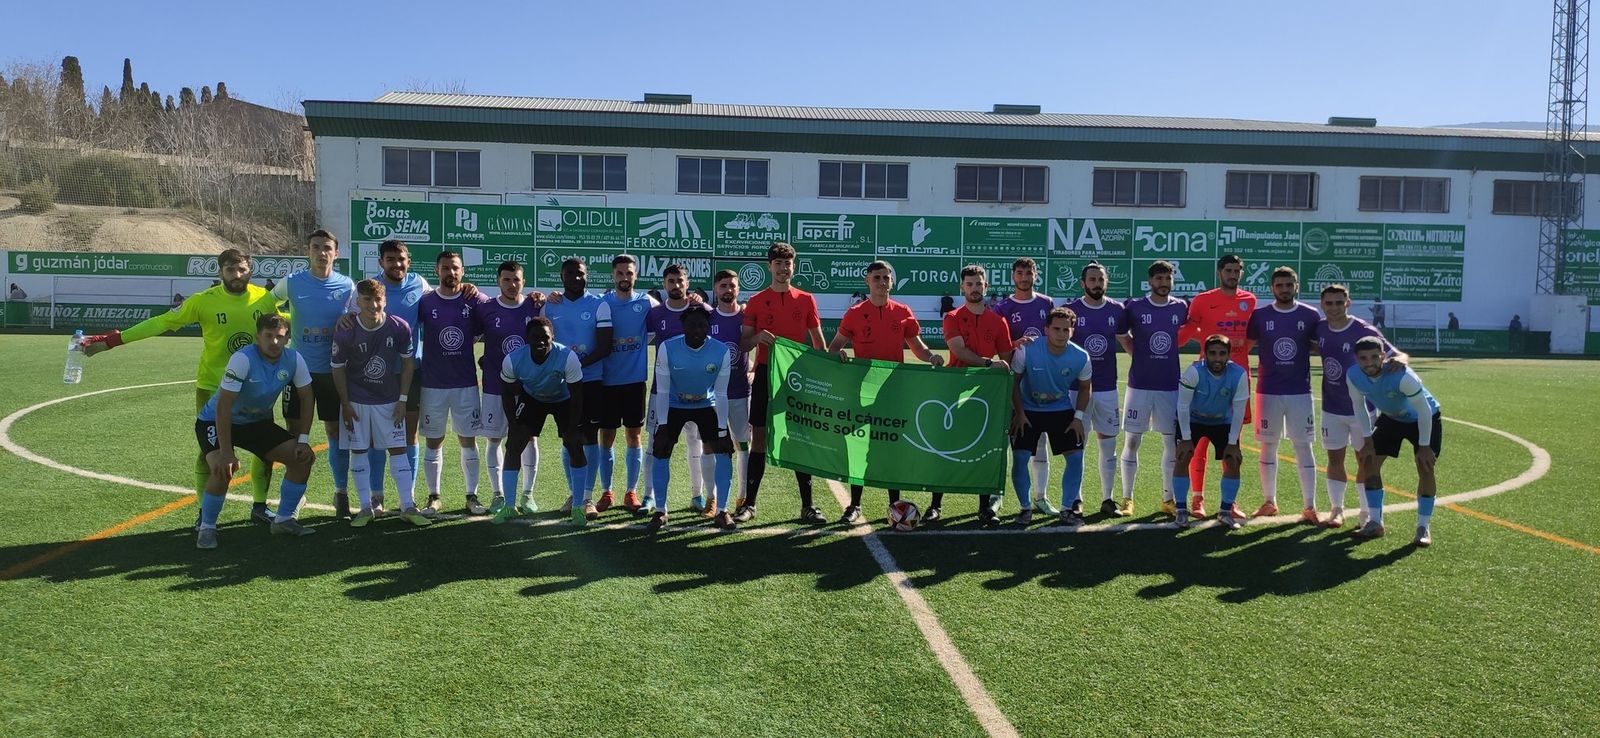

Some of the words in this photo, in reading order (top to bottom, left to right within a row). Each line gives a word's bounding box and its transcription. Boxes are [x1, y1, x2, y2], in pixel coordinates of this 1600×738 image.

[366, 201, 410, 219] Bolsas
[562, 209, 622, 227] OLIDUL
[395, 219, 429, 234] SEMA
[738, 232, 786, 240] CHURRI
[1048, 218, 1104, 250] NA
[1236, 228, 1282, 240] Manipulados
[626, 237, 712, 250] FERROMOBEL
[486, 250, 528, 262] Lacrist
[590, 254, 614, 265] pulid
[32, 256, 90, 271] guzmán
[92, 256, 129, 272] jódar
[910, 270, 958, 282] TORGA
[1351, 270, 1374, 278] WOOD
[1384, 272, 1430, 286] Espinosa
[1433, 272, 1462, 286] Zafra
[216, 313, 226, 324] 13
[432, 309, 438, 318] 5
[1012, 312, 1021, 322] 25
[496, 318, 500, 327] 2
[1077, 317, 1086, 326] 19
[1142, 314, 1152, 324] 30
[662, 320, 666, 330] 3
[712, 325, 719, 334] 10
[1266, 321, 1274, 331] 18
[358, 342, 368, 352] 17
[650, 410, 654, 420] 3
[786, 396, 832, 418] Contra
[837, 408, 851, 420] el
[855, 412, 908, 429] cáncer
[1128, 410, 1137, 420] 30
[426, 415, 430, 424] 5
[488, 414, 492, 423] 2
[1260, 419, 1268, 428] 18
[786, 410, 830, 432] somos
[834, 424, 866, 438] solo
[870, 430, 899, 442] uno
[207, 426, 215, 437] 3
